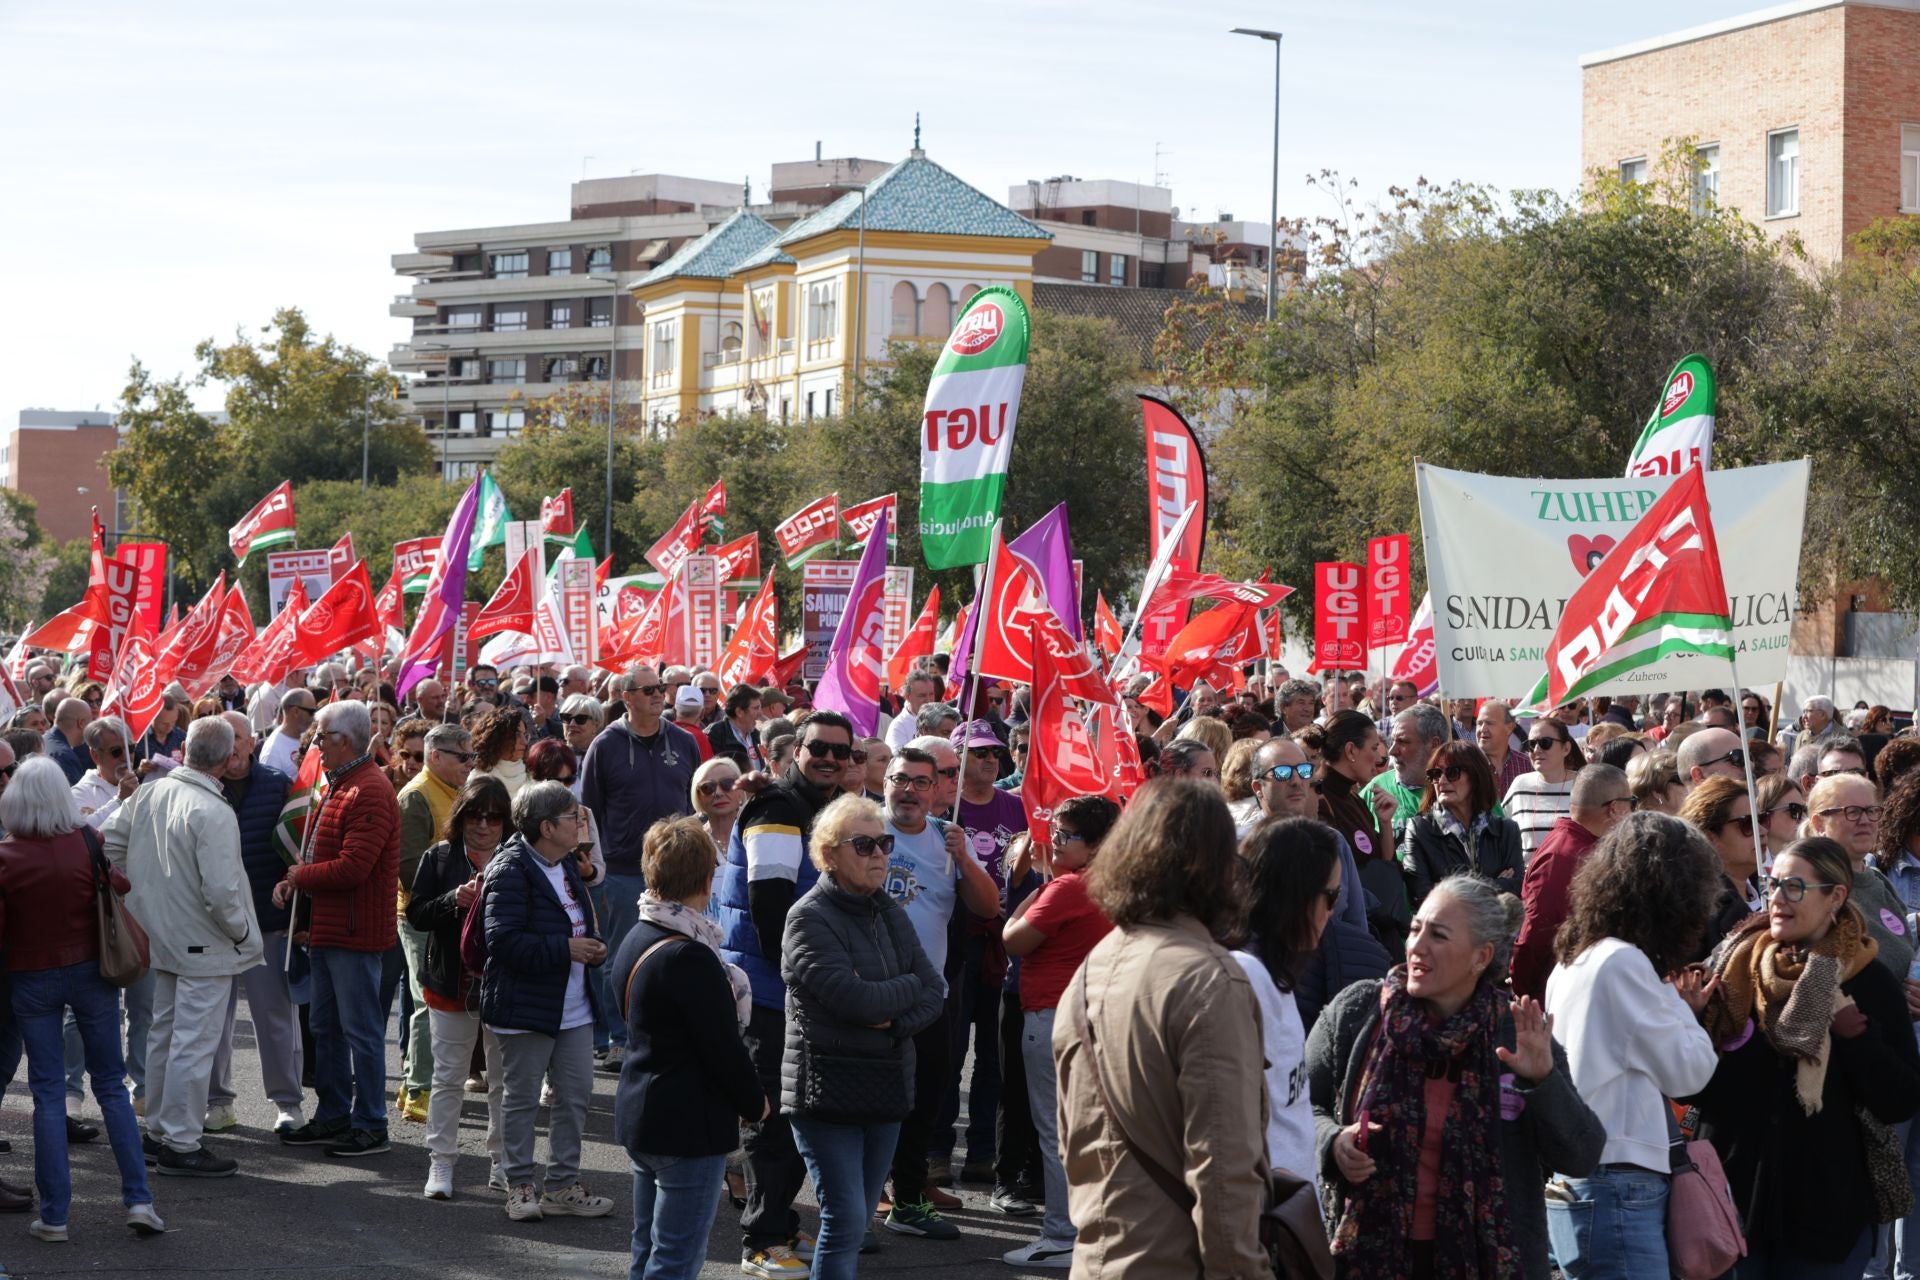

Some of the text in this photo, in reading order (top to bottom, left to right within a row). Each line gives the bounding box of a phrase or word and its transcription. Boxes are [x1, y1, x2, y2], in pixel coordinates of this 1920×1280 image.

[1531, 490, 1711, 522] ZUHE
[271, 557, 328, 573] CCOO
[804, 566, 856, 579] CCO
[1374, 541, 1400, 615] UGT
[805, 593, 848, 612] SANID
[1325, 568, 1358, 639] UGT
[1730, 592, 1790, 627] LICA
[569, 595, 587, 664] CCOO
[694, 594, 713, 668] CCOO
[818, 612, 841, 628] PÚB
[1490, 648, 1504, 661] LA
[1510, 647, 1545, 661] SANI
[1752, 635, 1788, 652] SALUD
[1628, 671, 1668, 682] Zuheros
